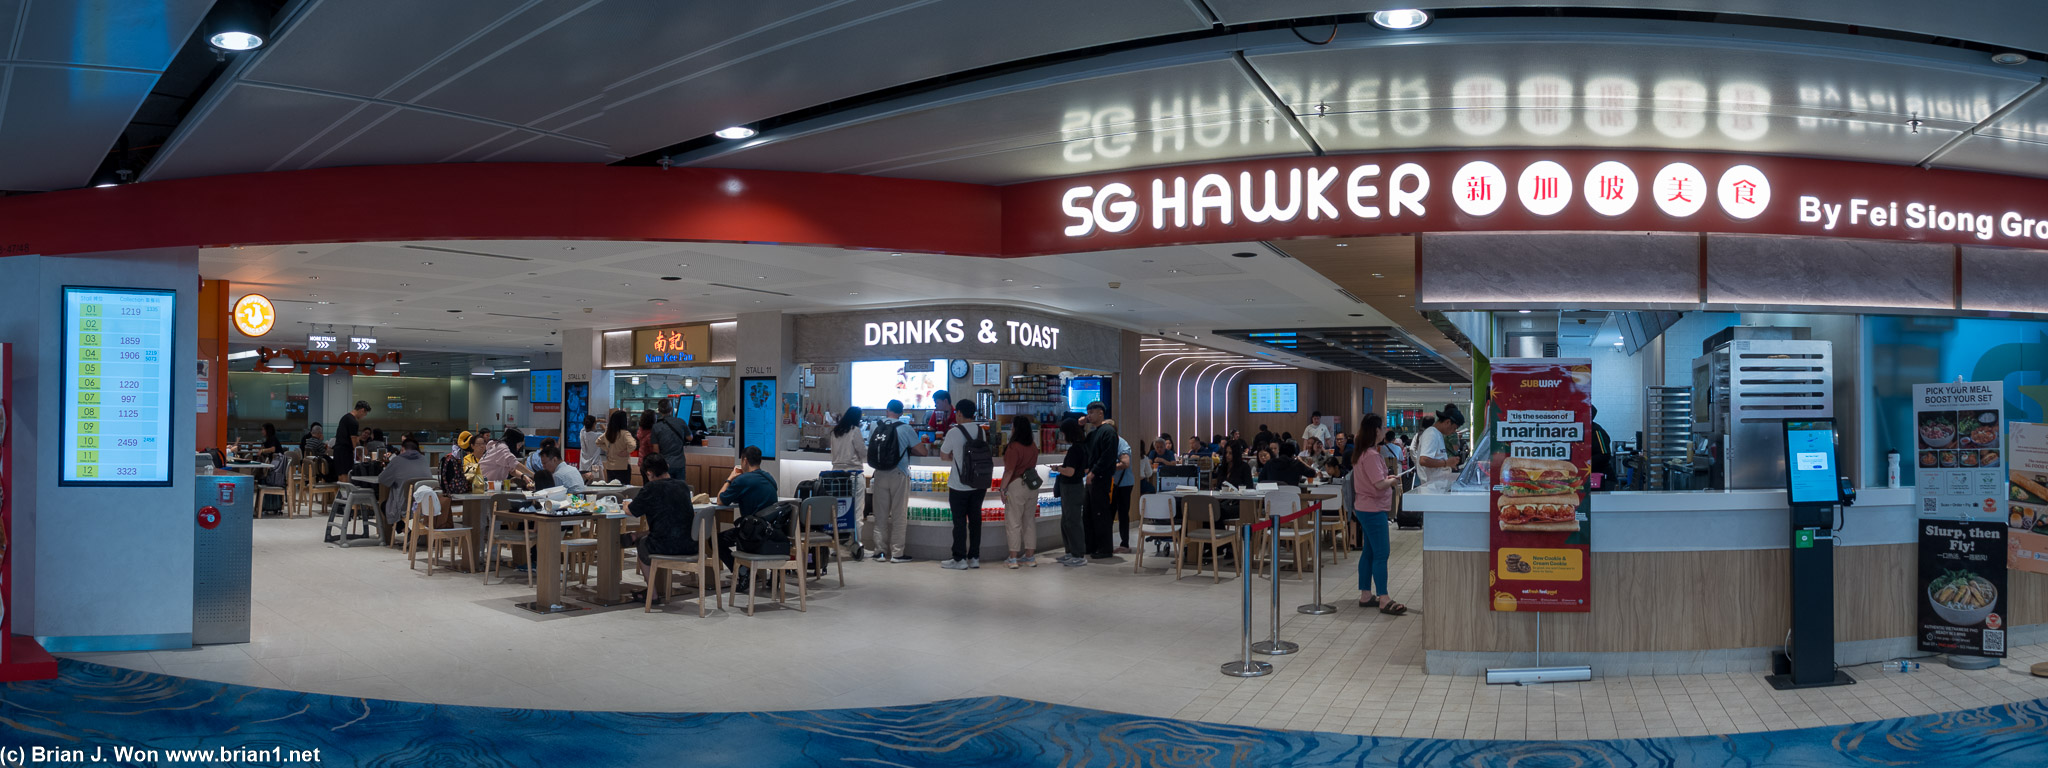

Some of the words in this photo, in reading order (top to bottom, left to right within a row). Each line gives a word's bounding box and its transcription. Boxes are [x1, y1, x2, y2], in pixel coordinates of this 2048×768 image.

[1464, 174, 1758, 206] 新加坡美食
[1061, 182, 1137, 236] SG
[1152, 162, 1430, 230] HAWKER
[1799, 195, 1842, 230] By
[1850, 198, 1898, 227] Fei
[1905, 202, 1993, 240] Siong
[86, 304, 96, 313] 01
[121, 307, 141, 316] 1219
[85, 319, 97, 328] 02
[85, 334, 96, 343] 03
[864, 318, 965, 346] DRINKS
[977, 318, 998, 344] &
[1006, 320, 1059, 350] TOAST
[120, 337, 141, 345] 1859
[654, 330, 684, 353] 南記
[85, 349, 96, 357] 04
[120, 351, 140, 360] 1906
[645, 353, 662, 363] Nam
[663, 352, 678, 362] Kee
[679, 351, 693, 361] Pau
[84, 363, 96, 372] 05
[745, 366, 765, 374] STALL
[766, 366, 772, 374] 11
[84, 378, 95, 387] 06
[119, 381, 140, 389] 1220
[1520, 380, 1562, 388] SUBWAY
[1925, 387, 1944, 395] PICK
[1946, 386, 1968, 394] YOUR
[1970, 385, 1992, 393] MEAL
[84, 393, 95, 401] 07
[121, 395, 137, 403] 997
[1925, 395, 1952, 404] BOOST
[1953, 395, 1976, 403] YOUR
[1977, 394, 1993, 402] SET
[84, 408, 95, 416] 08
[118, 409, 139, 418] 1125
[83, 422, 94, 430] 09
[1501, 423, 1578, 438] marinara
[84, 437, 94, 445] 10
[117, 438, 138, 447] 2459
[1514, 443, 1566, 457] mania
[84, 451, 92, 459] 11
[83, 466, 93, 474] 12
[116, 467, 137, 475] 3323
[1925, 525, 1966, 539] Slurp,
[1969, 527, 2000, 539] then
[1949, 540, 1975, 553] Fly!
